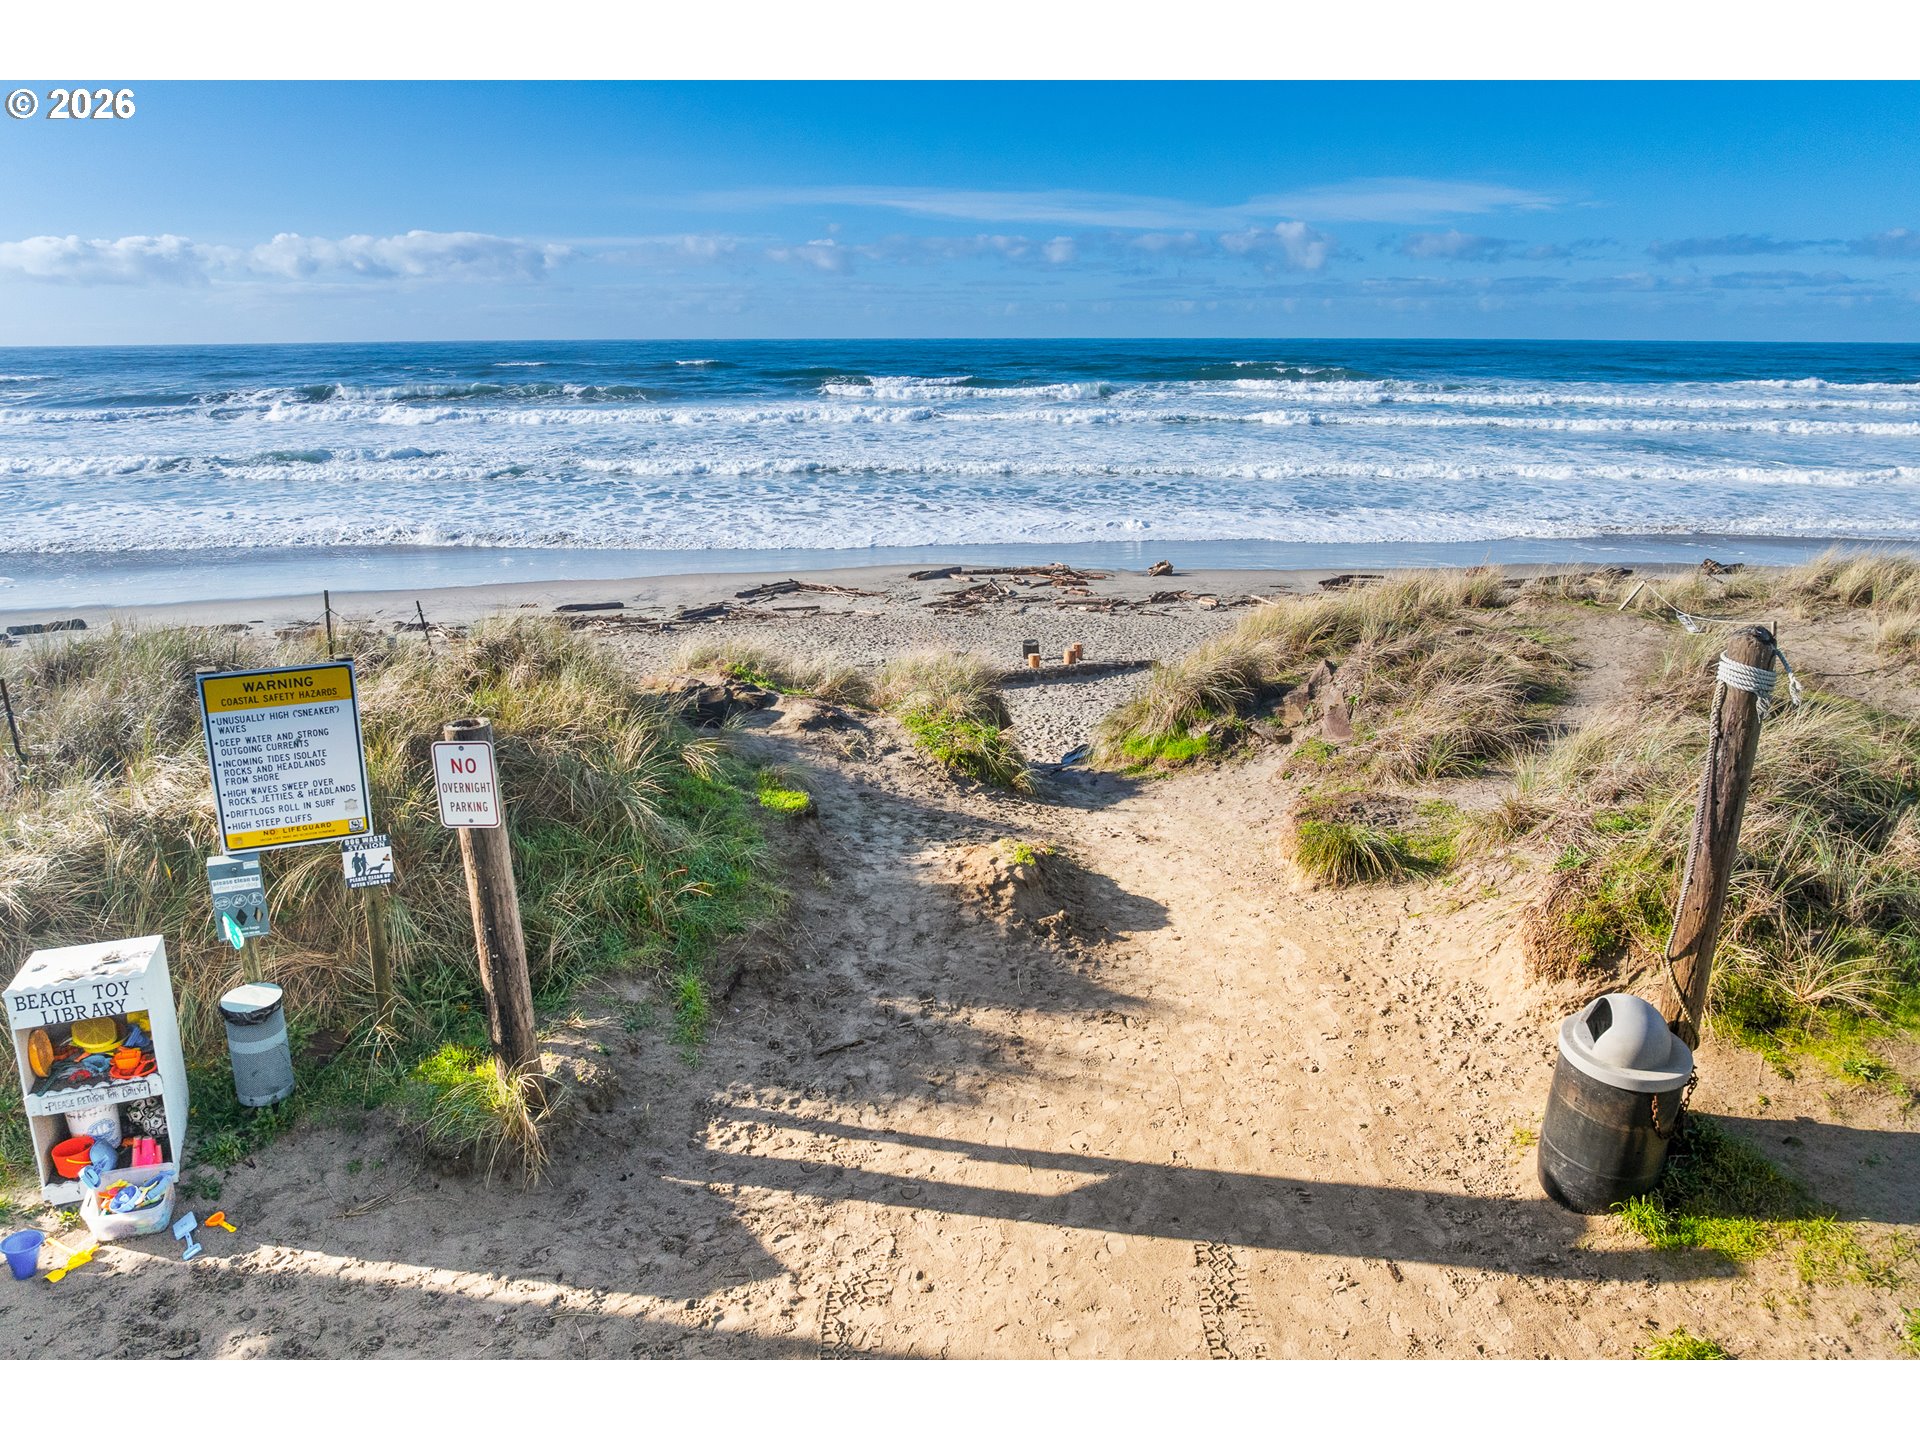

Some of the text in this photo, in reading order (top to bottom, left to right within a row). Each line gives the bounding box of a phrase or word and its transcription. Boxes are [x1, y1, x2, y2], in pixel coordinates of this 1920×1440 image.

[242, 676, 314, 692] WARNING
[221, 688, 337, 707] COASTAL SAFETY HAZARDS
[216, 713, 265, 726] UNUSUALLY
[270, 711, 289, 720] HIGH
[218, 725, 247, 734] WAVES
[220, 728, 329, 747] DEEP WATER AND STRONG
[221, 740, 309, 756] OUTGOING CURRENTS
[223, 749, 327, 768] INCOMING TIDES ISOLATE
[450, 758, 476, 774] NO
[224, 759, 326, 777] ROCKS AND HEADLANDS
[225, 772, 280, 786] FROM SHORE
[227, 778, 334, 798] HIGH WAVES SWEEP OVER
[308, 784, 356, 797] HEADLANDS
[442, 782, 490, 793] OVERNIGHT
[230, 799, 336, 819] DRIFTLOGS ROLL IN SURF
[450, 802, 489, 812] PARKING
[232, 814, 312, 830] HIGH STEEP CLIFFS
[283, 822, 332, 834] LIFEGUARD
[348, 842, 385, 851] STATION
[14, 981, 130, 1011] BEACH TOY
[41, 999, 126, 1025] LIBRARY
[77, 1092, 105, 1105] RETURN
